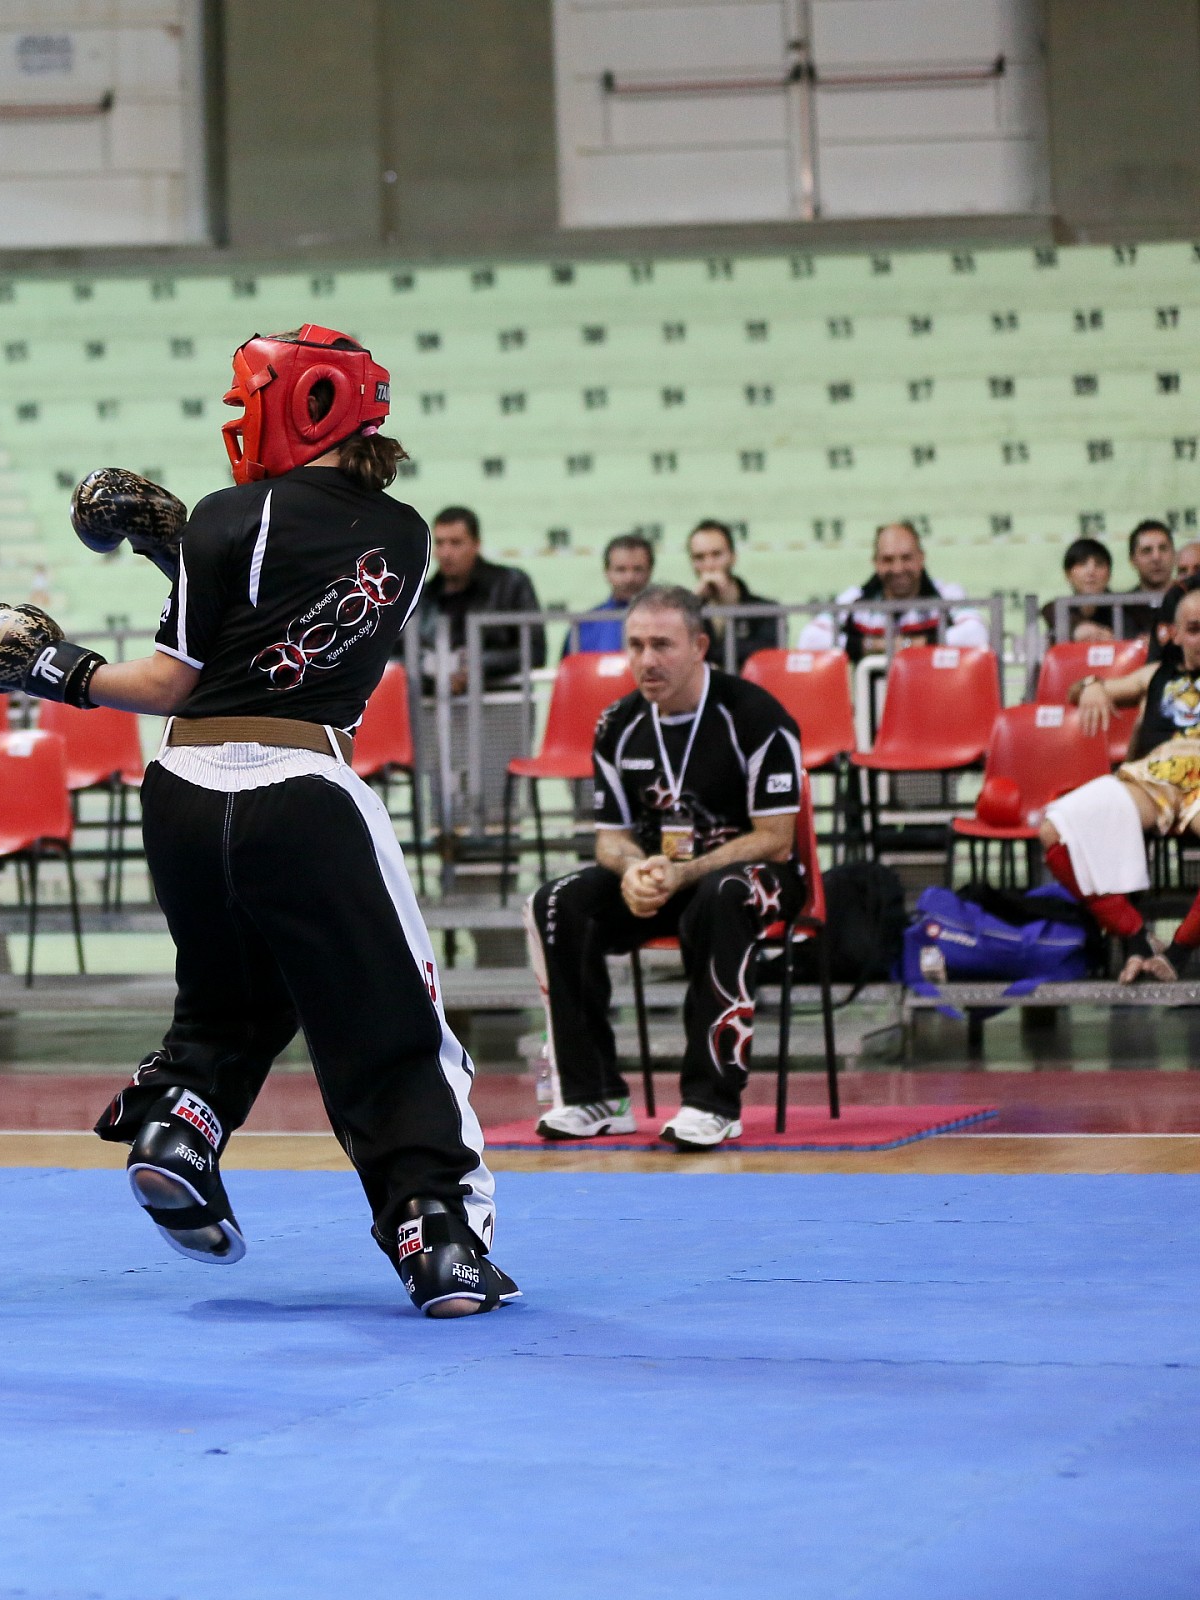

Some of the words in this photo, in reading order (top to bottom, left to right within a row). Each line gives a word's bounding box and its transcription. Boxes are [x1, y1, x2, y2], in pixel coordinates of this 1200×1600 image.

[176, 1105, 217, 1147] RING
[186, 1097, 220, 1135] TOP
[174, 1146, 205, 1172] RING
[397, 1226, 419, 1244] OP
[452, 1268, 480, 1284] RING
